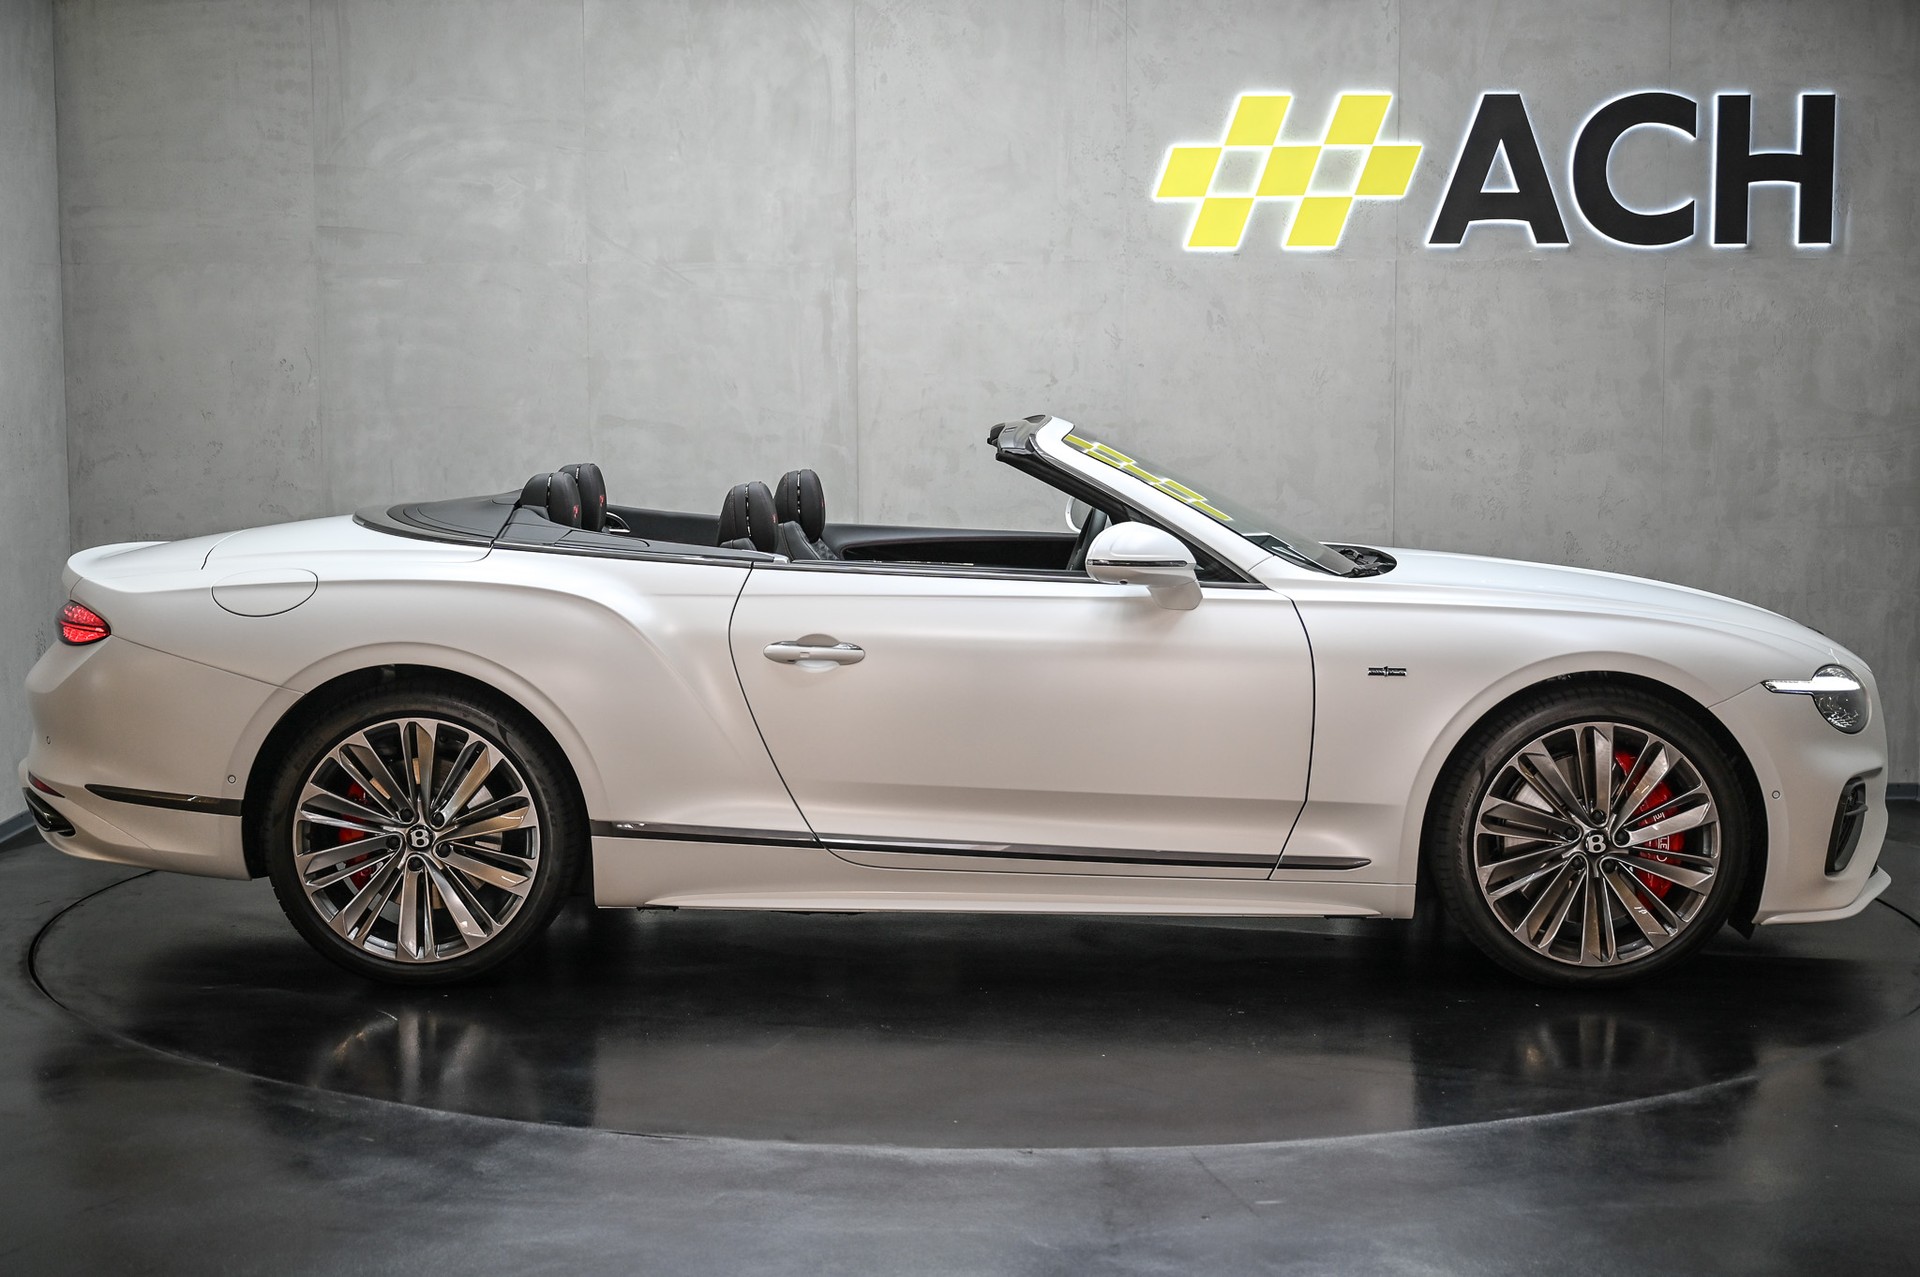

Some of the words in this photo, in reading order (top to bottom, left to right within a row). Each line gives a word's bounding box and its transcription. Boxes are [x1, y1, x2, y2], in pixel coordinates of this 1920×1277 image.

[1427, 92, 1836, 247] ACH
[410, 829, 430, 848] B
[1587, 834, 1607, 853] B
